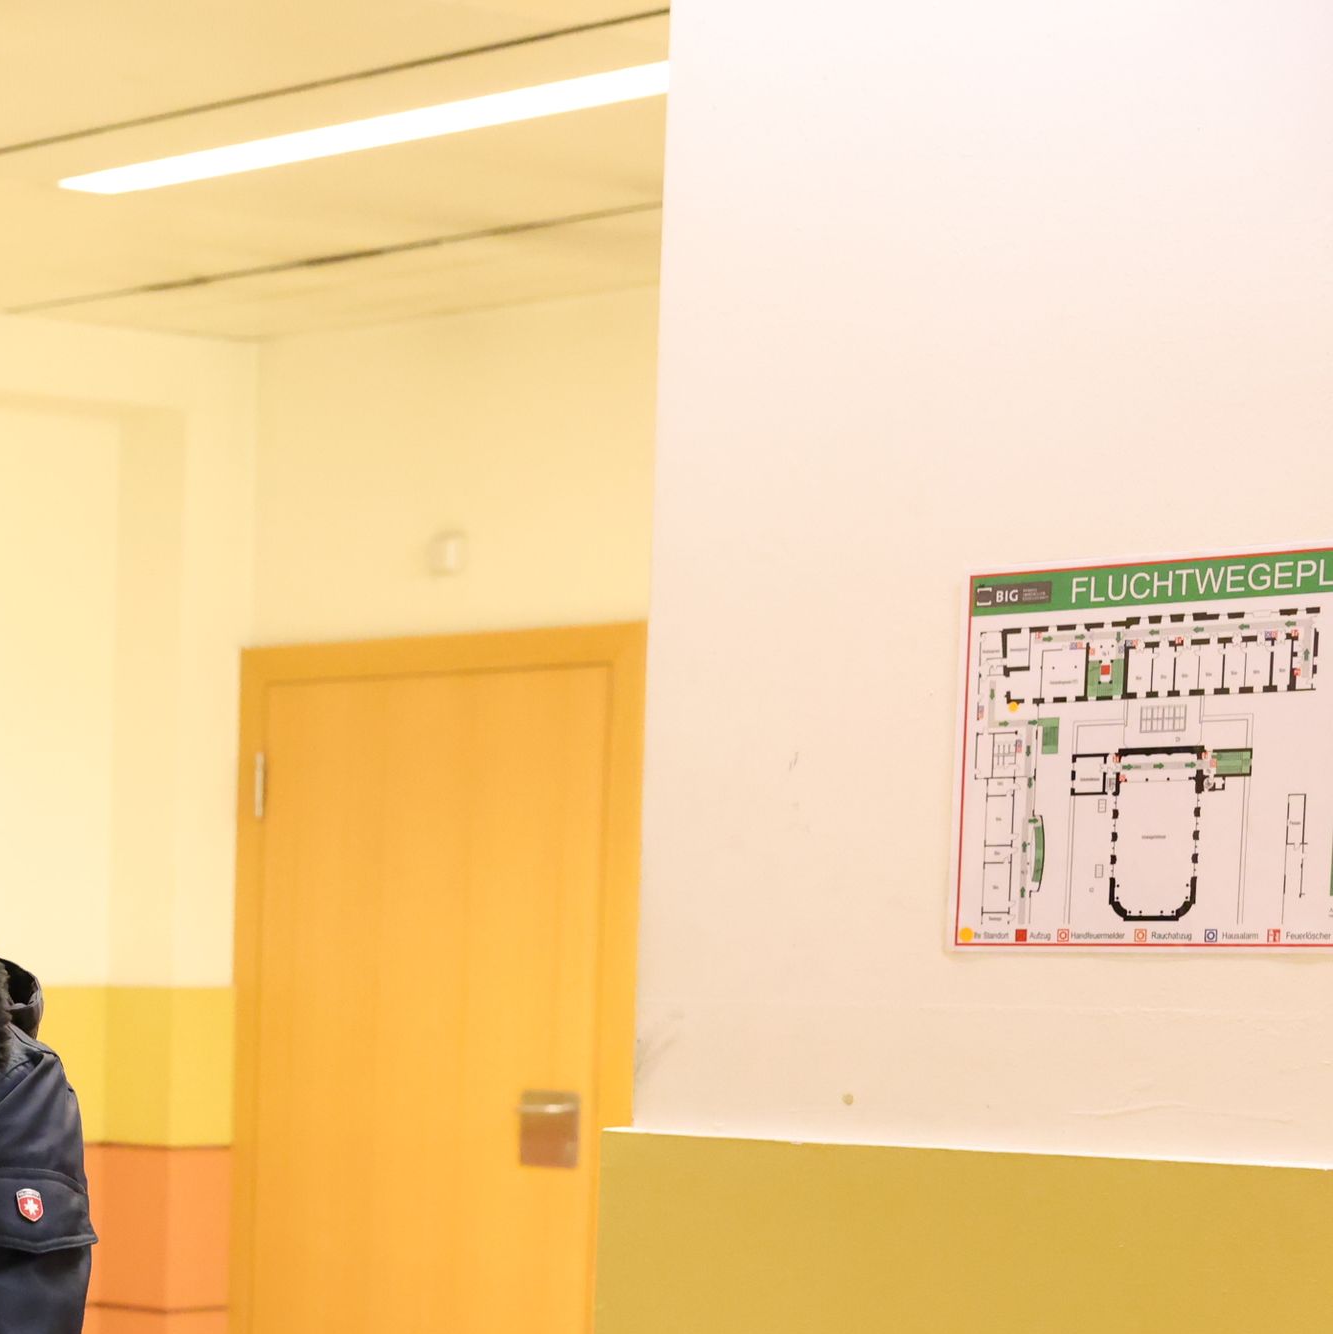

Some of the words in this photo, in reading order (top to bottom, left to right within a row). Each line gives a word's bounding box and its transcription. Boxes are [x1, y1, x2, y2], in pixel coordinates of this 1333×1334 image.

[1071, 559, 1333, 604] FLUCHTWEGEPL
[996, 589, 1019, 603] BIG
[983, 931, 1009, 940] Standort
[1070, 931, 1125, 940] Handfeuermelder
[1151, 931, 1192, 941] Rauchabzug
[1221, 931, 1259, 940] Hausalarm
[1285, 931, 1332, 940] Feuerlöscher
